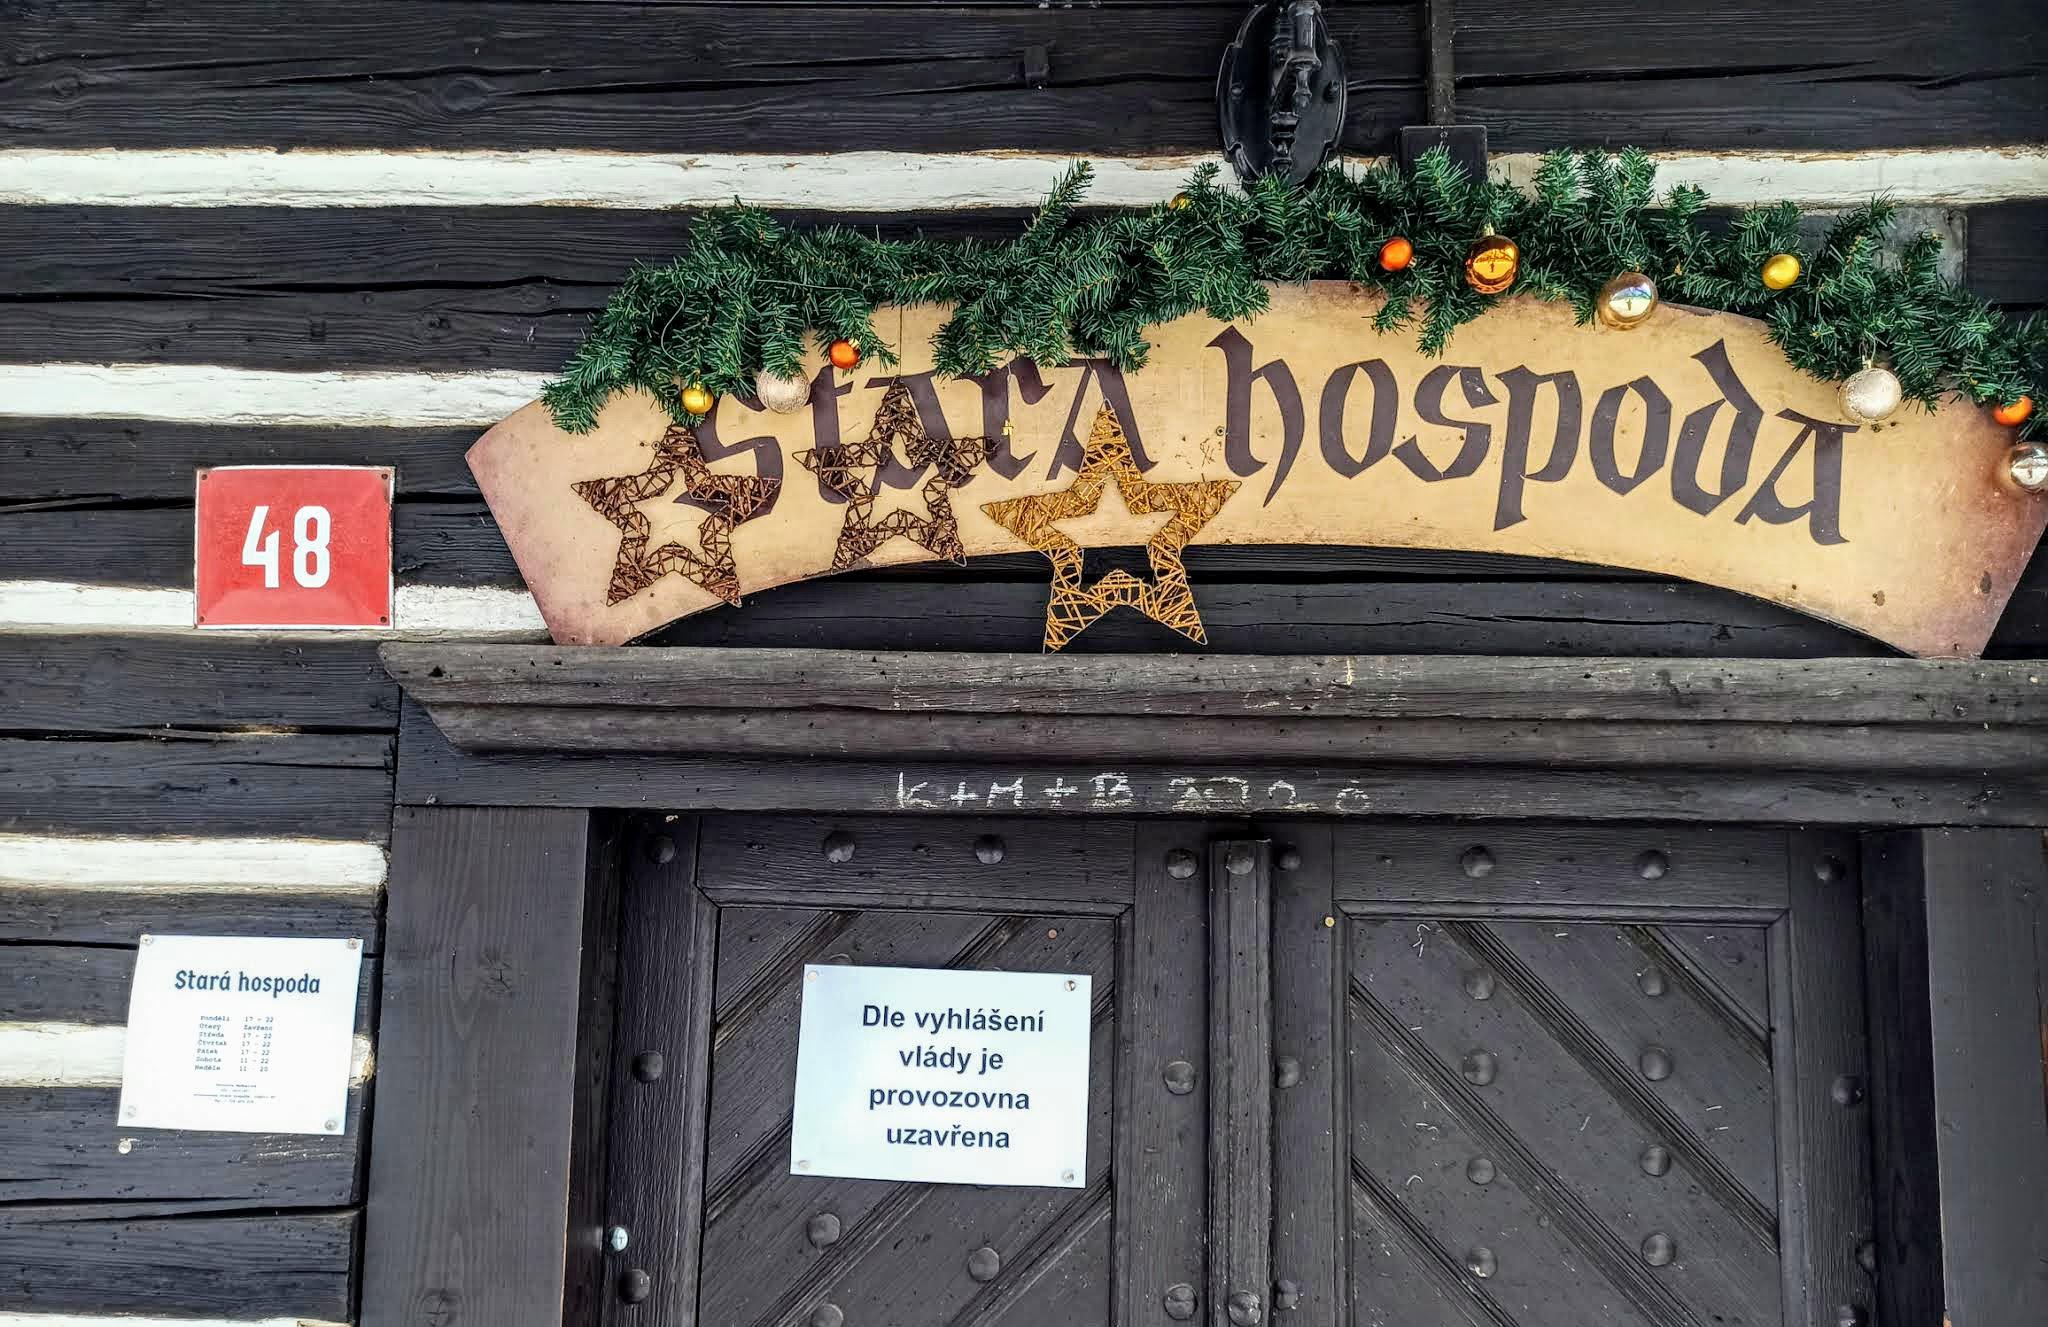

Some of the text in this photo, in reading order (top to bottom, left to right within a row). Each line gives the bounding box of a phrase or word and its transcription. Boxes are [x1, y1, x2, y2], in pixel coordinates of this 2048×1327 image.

[1205, 323, 1861, 546] hospoda
[241, 505, 332, 588] 48
[174, 969, 321, 998] Stará hospoda
[861, 1004, 1046, 1034] Dle vyhlášení
[899, 1046, 1004, 1075] vlády je
[869, 1088, 1030, 1111] provozovna
[886, 1125, 1010, 1149] uzavřena
